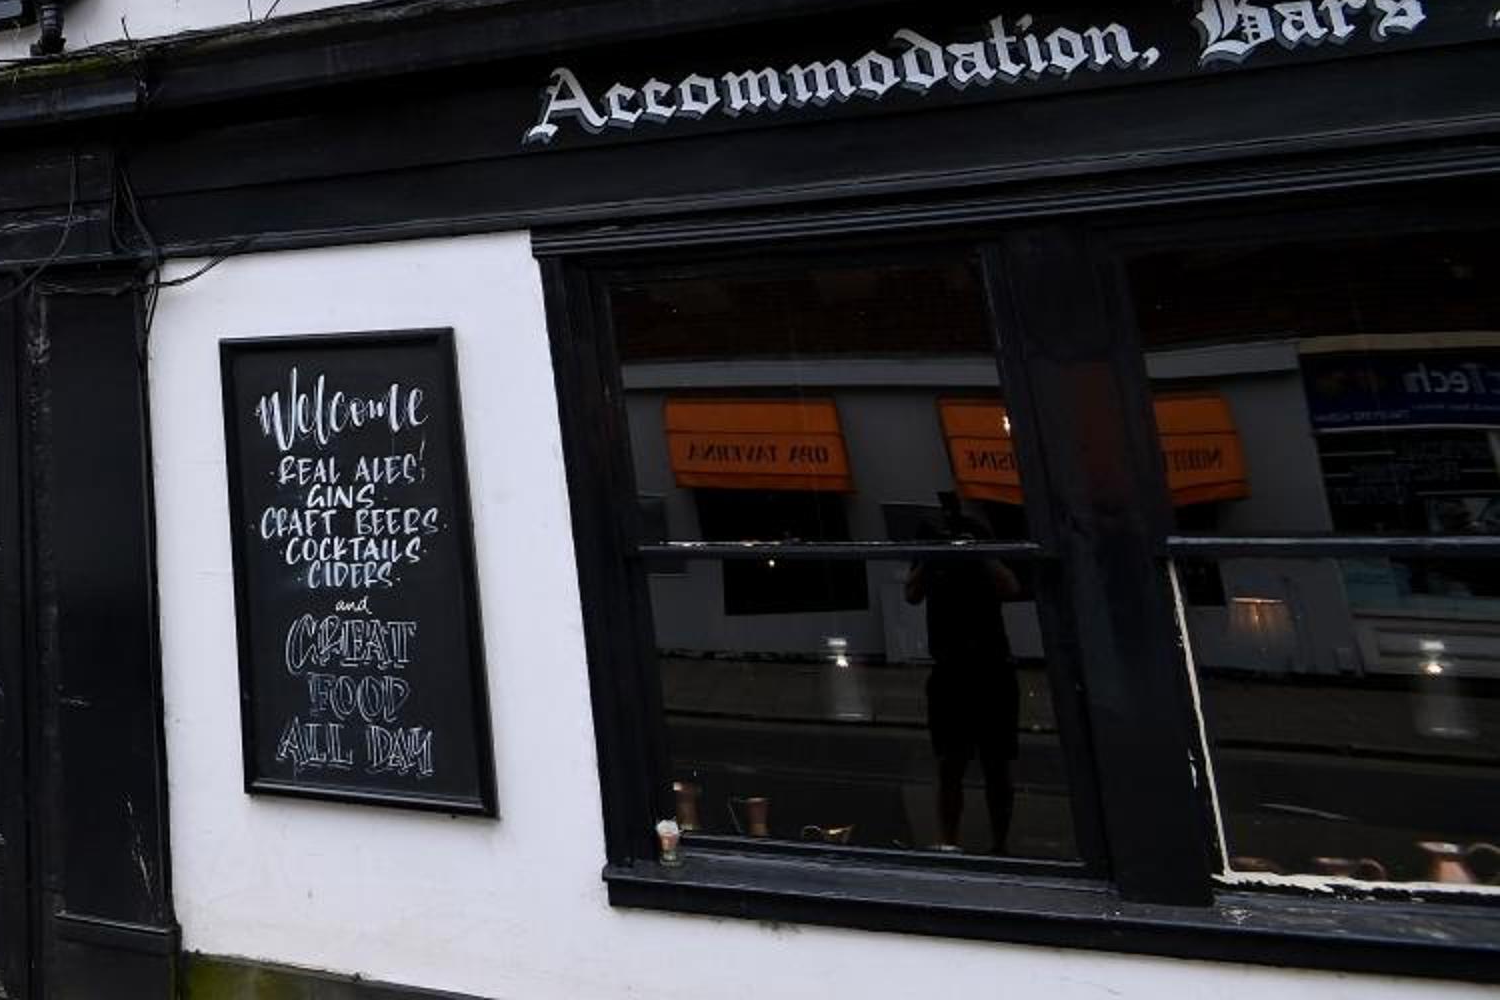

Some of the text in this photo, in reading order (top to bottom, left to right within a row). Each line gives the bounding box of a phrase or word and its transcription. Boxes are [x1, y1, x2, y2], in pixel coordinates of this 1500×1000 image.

[522, 14, 1161, 143] Accommodation,
[257, 366, 428, 451] Welcome
[278, 455, 341, 485] REAL
[307, 483, 376, 509] GINS
[261, 507, 439, 540] CRAFT BEERS
[285, 536, 421, 565] COCKTAILS
[307, 560, 393, 589] CIDERS
[335, 595, 373, 615] and
[286, 613, 418, 675] GREAT
[307, 671, 411, 722] FOOD
[276, 717, 354, 770] ALL
